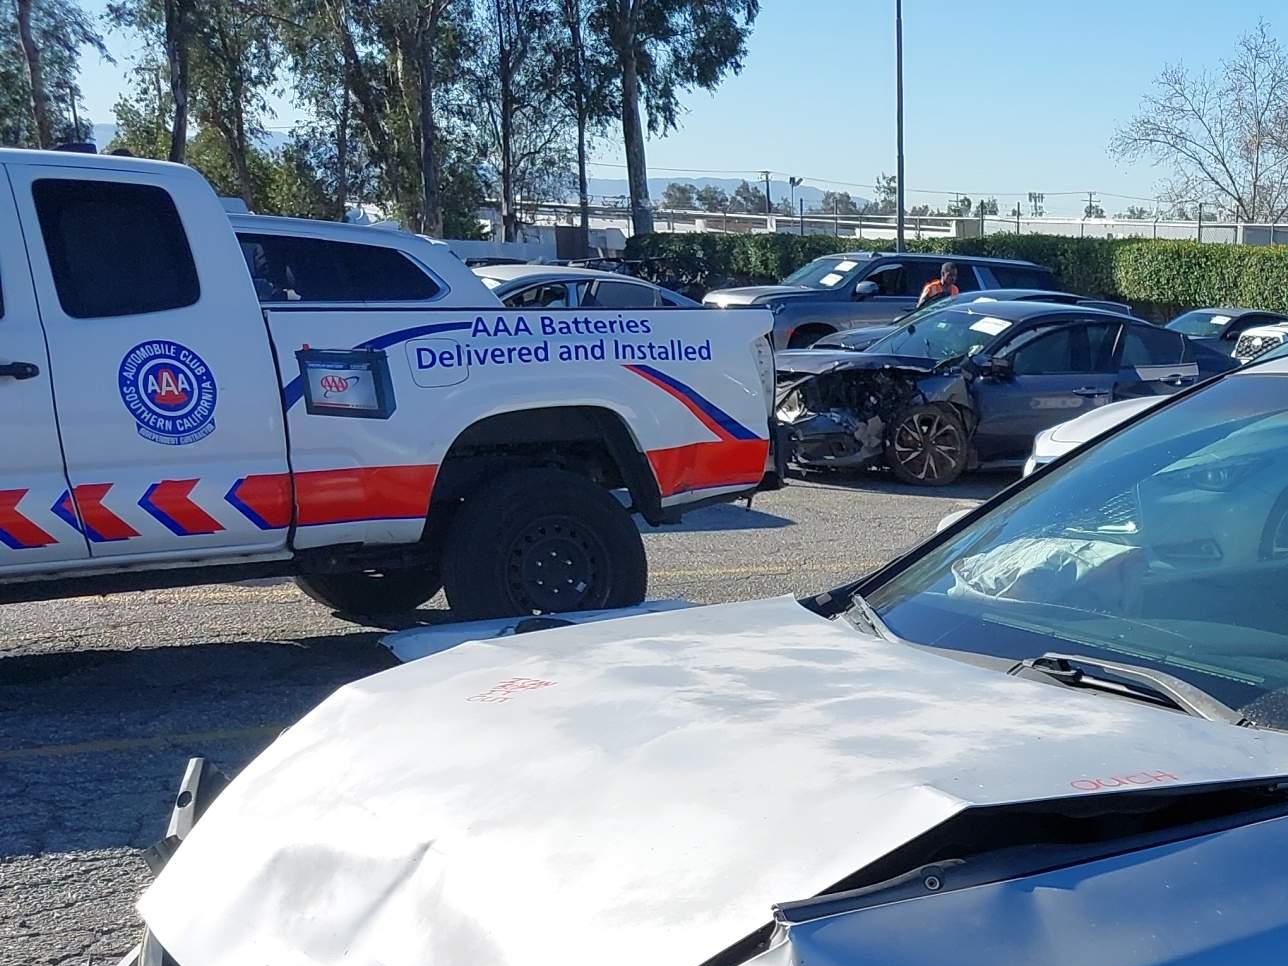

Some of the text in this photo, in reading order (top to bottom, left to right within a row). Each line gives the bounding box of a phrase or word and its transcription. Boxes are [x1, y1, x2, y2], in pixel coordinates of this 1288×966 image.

[472, 314, 652, 337] AAA Batteries
[122, 343, 206, 381] AUTOMOBILE CLUB
[416, 338, 712, 370] Delivered and Installed
[147, 371, 191, 396] AAA
[123, 380, 215, 431] SOUTHERN CALIFORNIA
